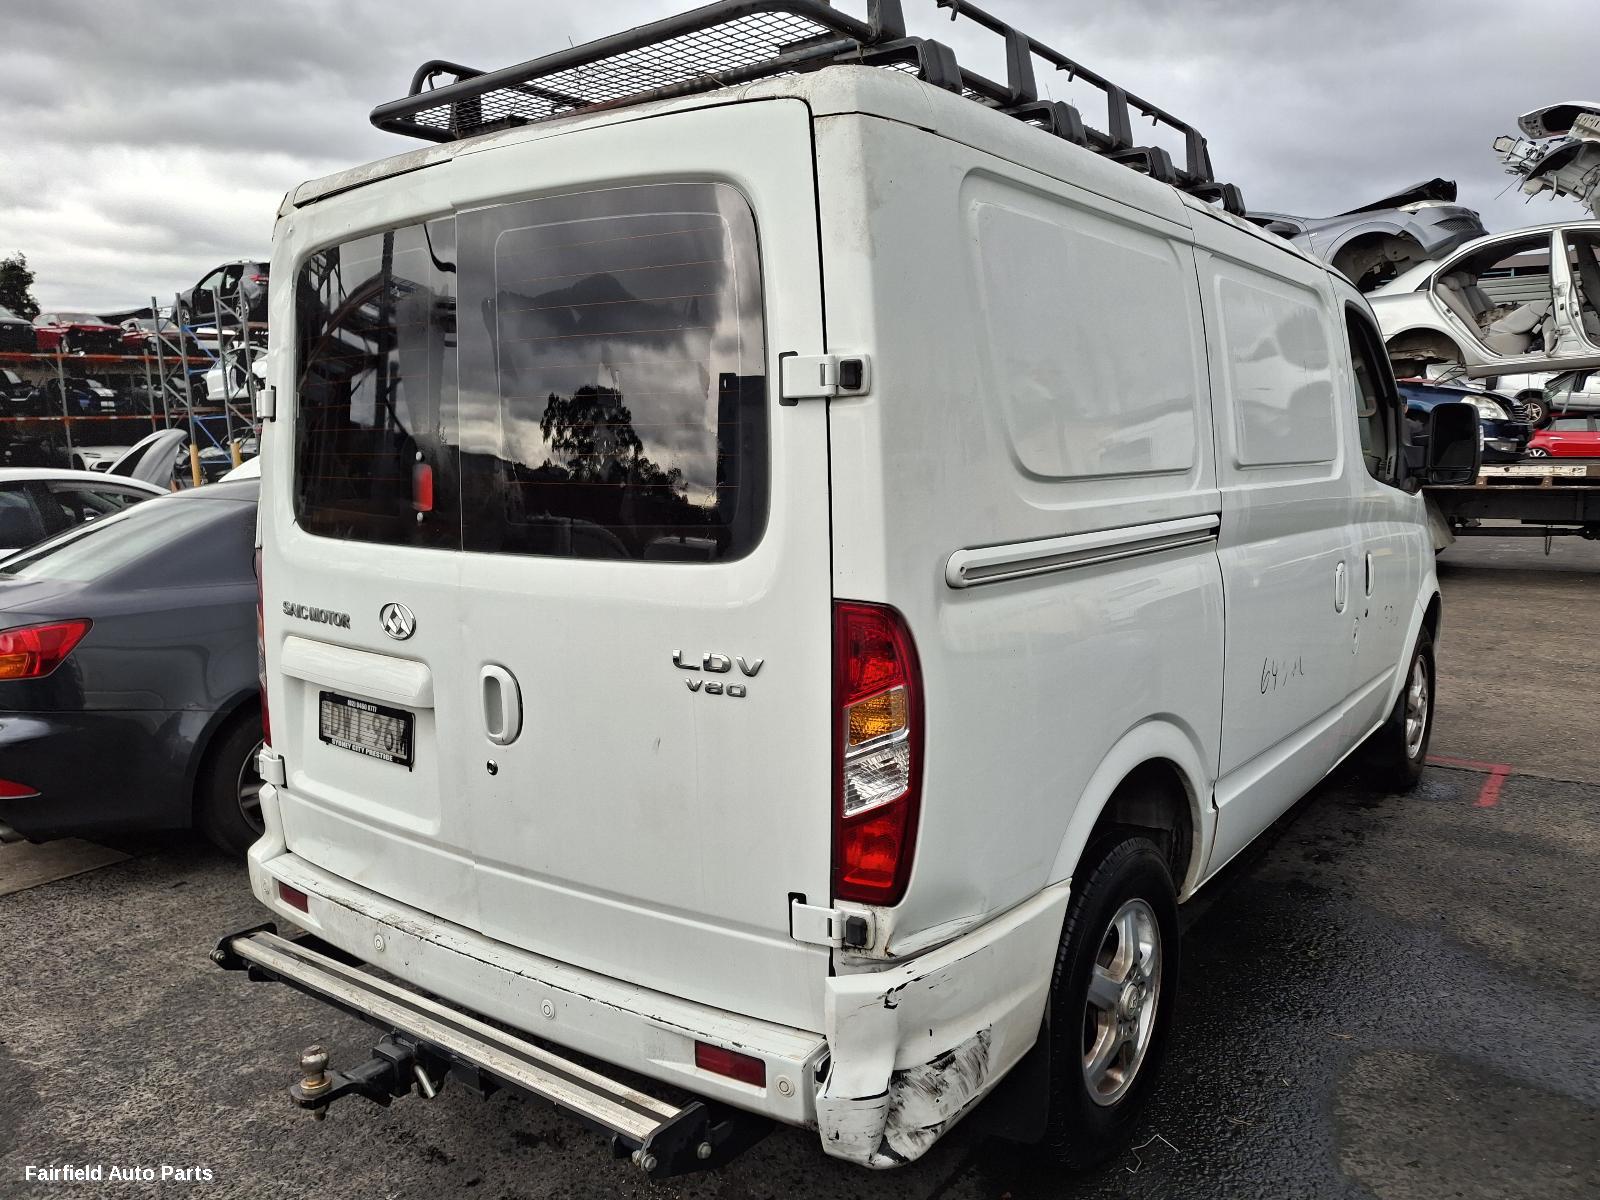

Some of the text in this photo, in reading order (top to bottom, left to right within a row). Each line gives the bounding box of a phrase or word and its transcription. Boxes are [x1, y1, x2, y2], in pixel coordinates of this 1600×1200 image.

[282, 600, 351, 629] SAIC MOTOR
[672, 648, 765, 677] LDV
[685, 677, 747, 698] V80
[351, 744, 365, 754] CITY
